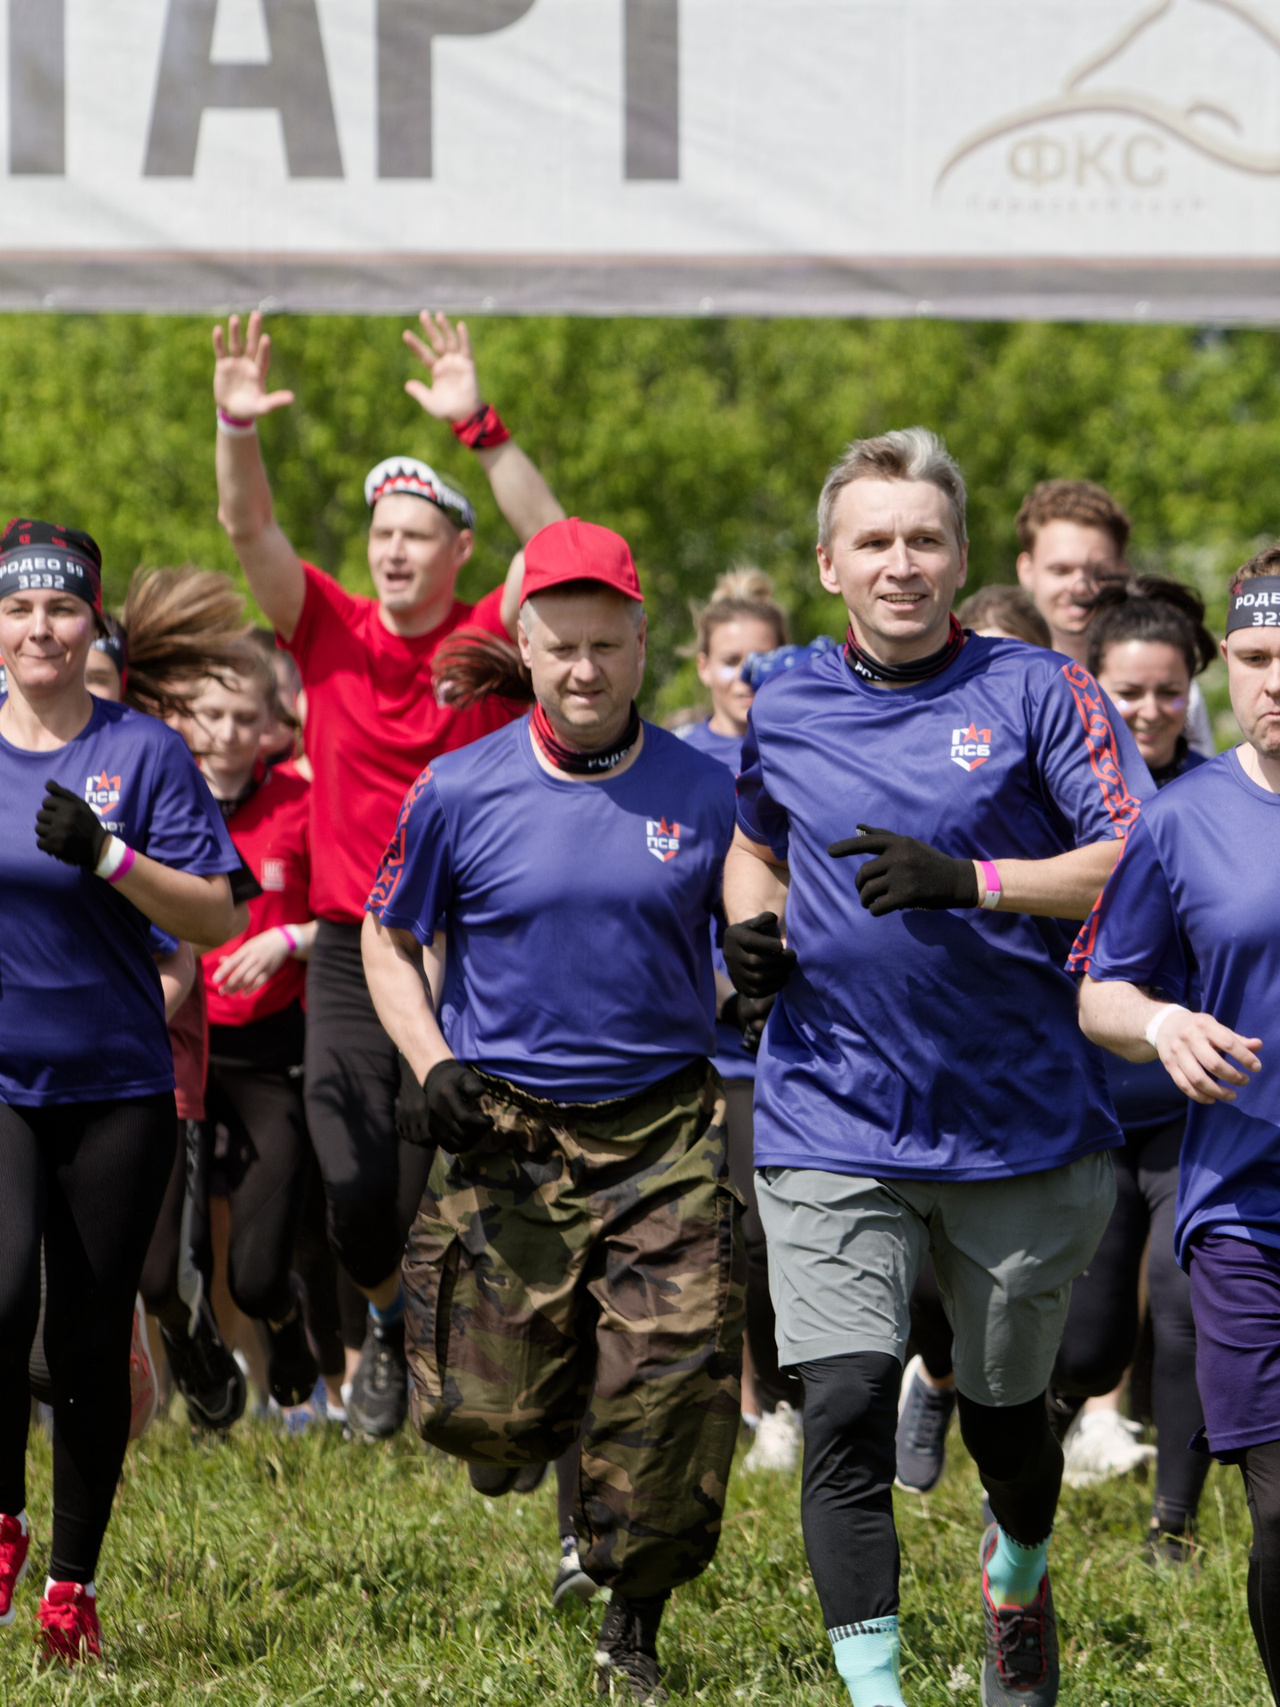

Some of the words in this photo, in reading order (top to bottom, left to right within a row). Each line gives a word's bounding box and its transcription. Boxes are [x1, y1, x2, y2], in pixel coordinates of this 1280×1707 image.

[1006, 133, 1168, 190] ФКС
[0, 556, 61, 579] РОДЕО
[18, 574, 65, 590] 3232
[950, 744, 991, 757] ПСБ
[85, 790, 120, 804] ПСБ
[646, 836, 680, 850] ПСБ
